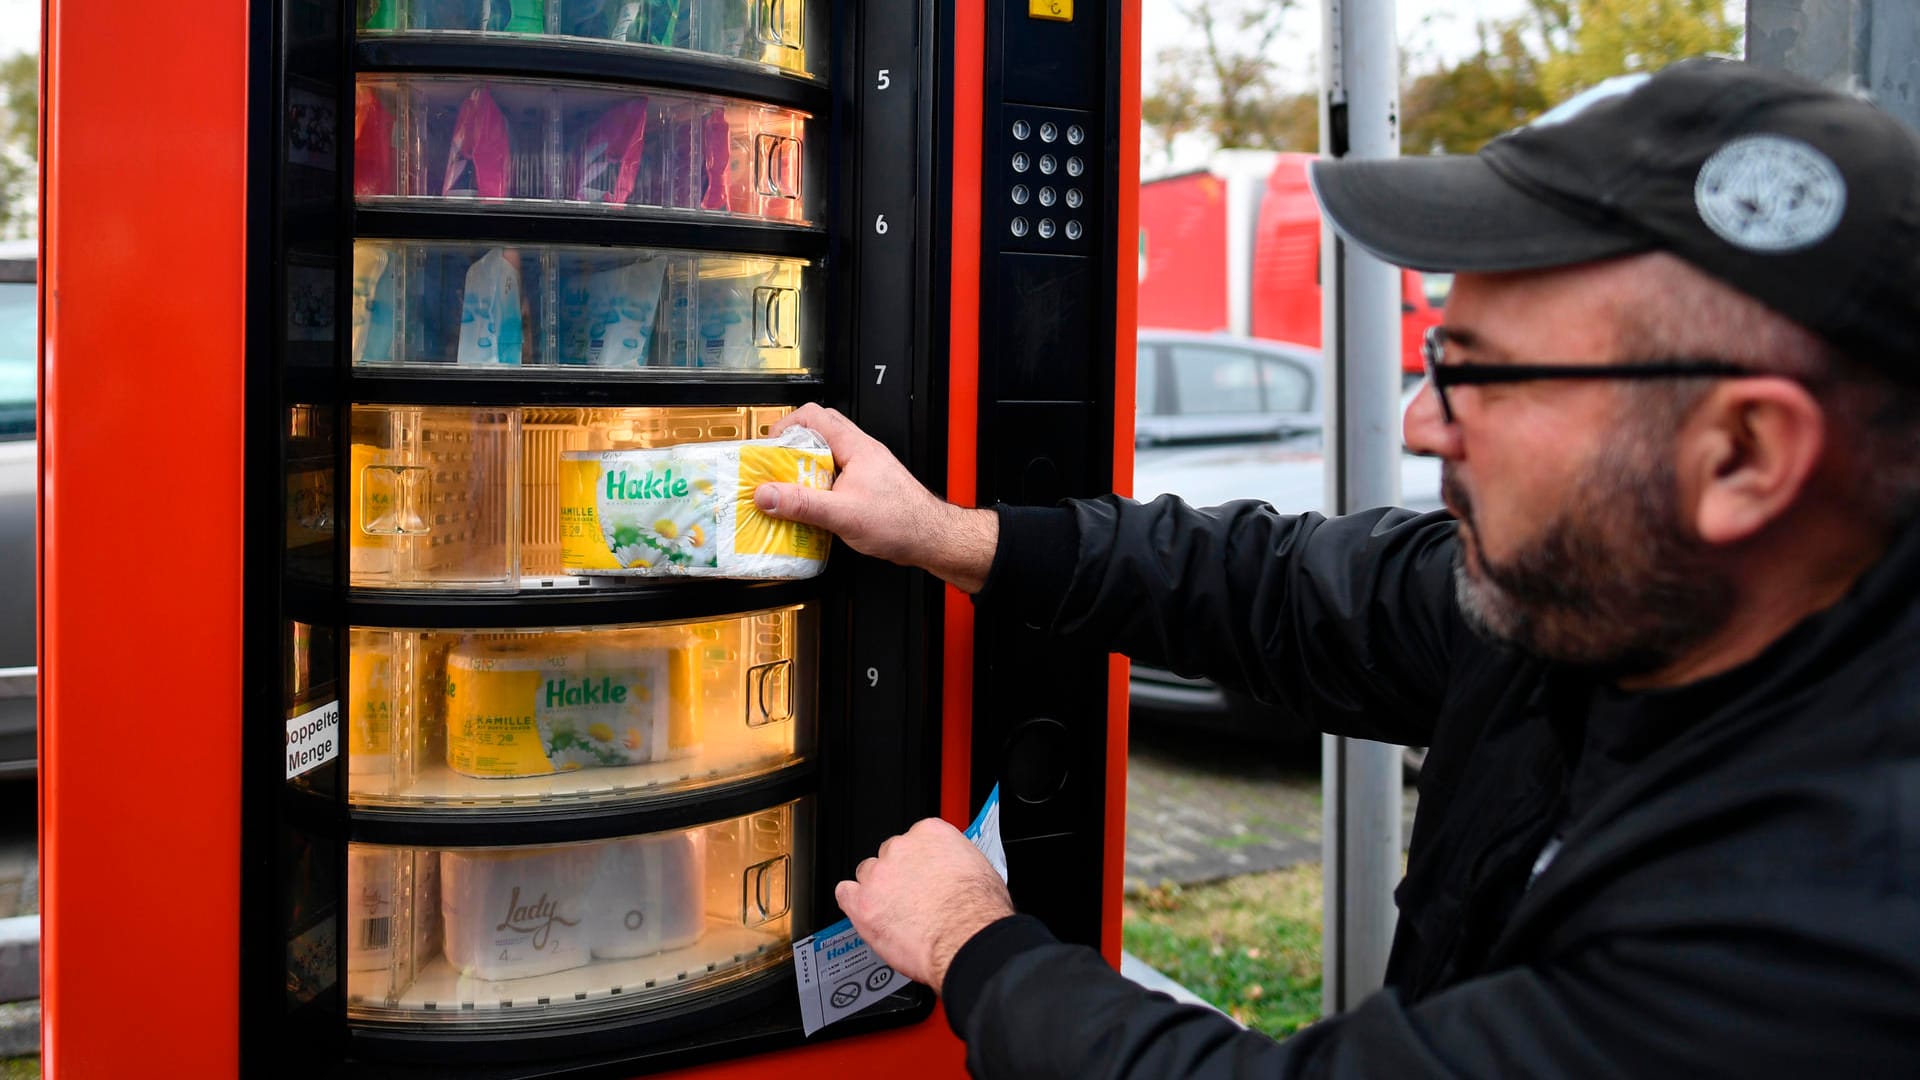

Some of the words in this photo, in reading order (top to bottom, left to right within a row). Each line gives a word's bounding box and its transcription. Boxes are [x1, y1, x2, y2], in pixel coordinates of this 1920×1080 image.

[877, 69, 890, 90] 5
[1015, 155, 1024, 170] 4
[875, 214, 888, 235] 6
[874, 364, 887, 385] 7
[606, 468, 689, 501] Hakle
[866, 667, 879, 687] 9
[545, 676, 628, 709] Hakle
[286, 711, 340, 746] oppelte
[476, 715, 532, 726] KAMILLE
[288, 739, 333, 772] Menge
[496, 886, 582, 950] Lady
[873, 971, 887, 985] 10
